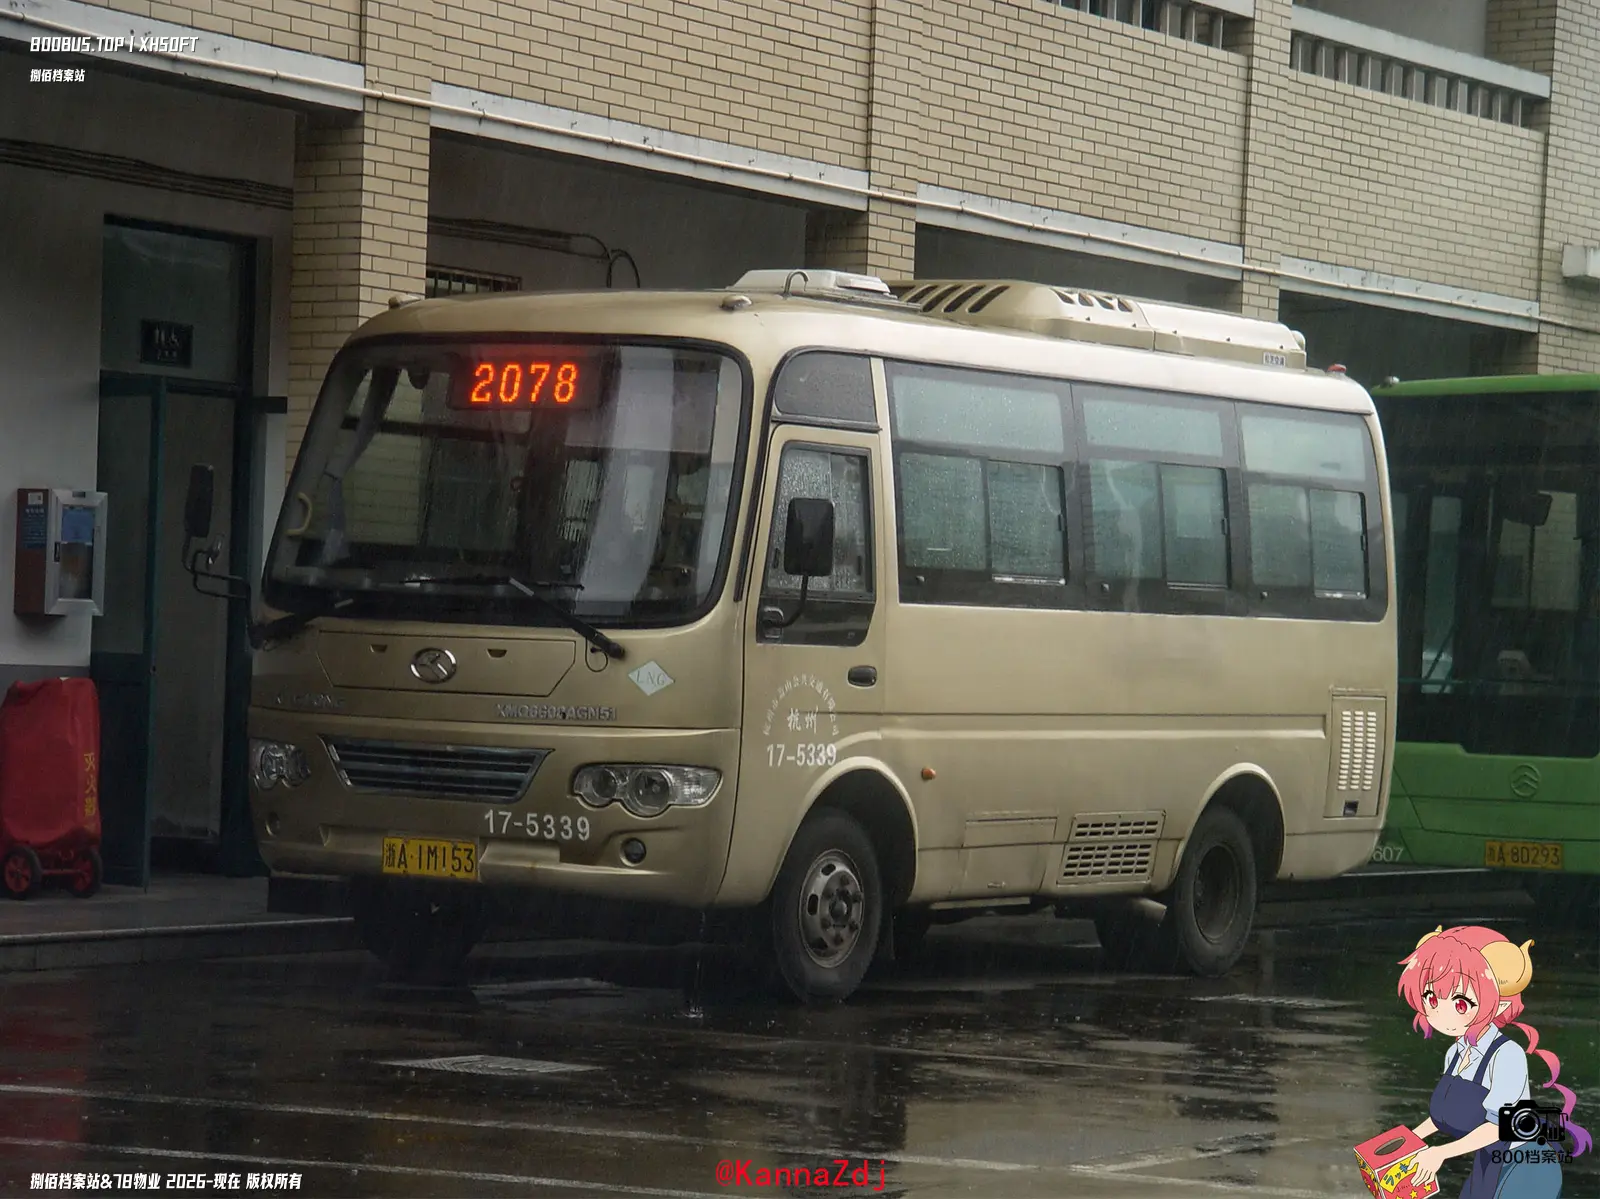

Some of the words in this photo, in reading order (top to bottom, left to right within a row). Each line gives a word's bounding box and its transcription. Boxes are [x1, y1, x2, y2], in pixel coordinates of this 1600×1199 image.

[470, 361, 578, 404] 2078
[636, 669, 666, 686] LNG
[787, 705, 819, 735] 杭州
[766, 743, 838, 767] 17-5339
[483, 808, 591, 842] 17-5339
